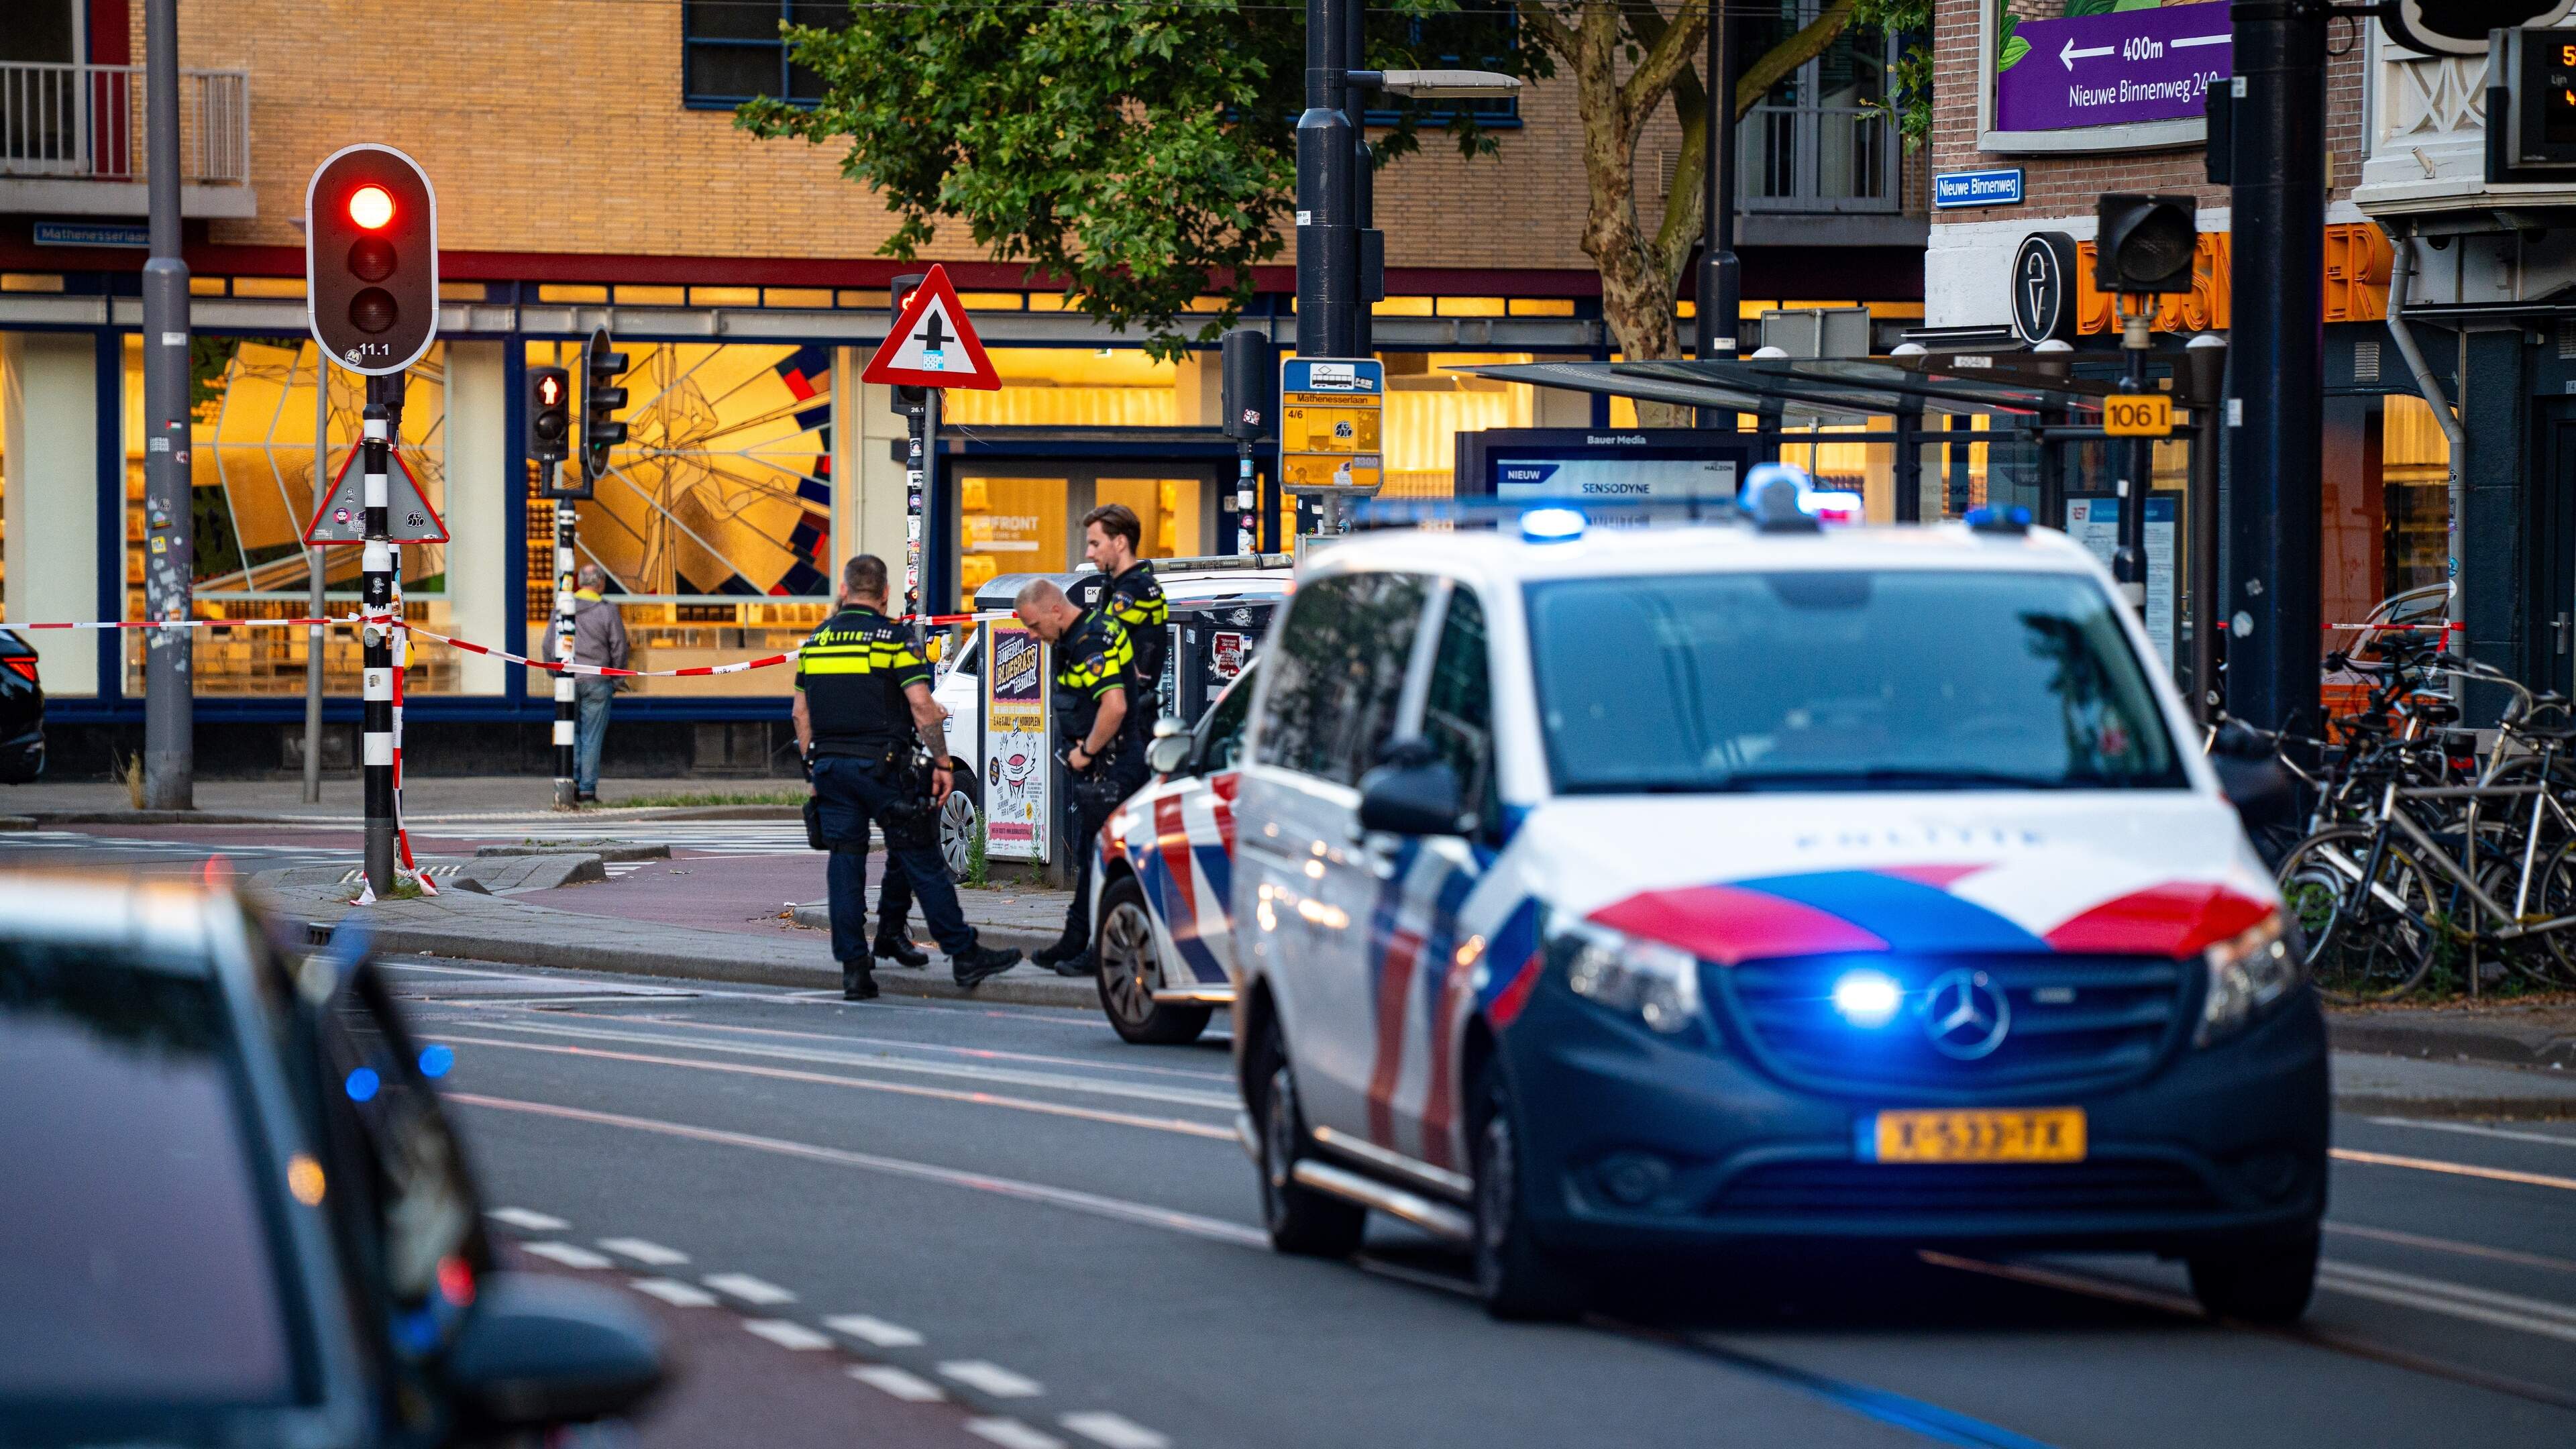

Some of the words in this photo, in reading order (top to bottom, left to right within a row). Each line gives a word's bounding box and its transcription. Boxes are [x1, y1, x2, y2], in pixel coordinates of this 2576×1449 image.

[2123, 36, 2163, 61] 400m
[2070, 85, 2116, 107] Nieuwe
[2120, 79, 2192, 103] Binnenweg
[1939, 180, 1969, 196] Nieuwe
[1971, 178, 2016, 197] Binnenweg
[360, 343, 389, 356] 11.1
[1297, 393, 1368, 404] Mathenesserlaan
[1288, 410, 1303, 419] 4/6
[1587, 435, 1615, 444] Bauer
[1617, 435, 1646, 444] Media
[1507, 470, 1540, 480] NIEUW
[1582, 483, 1650, 494] SENSODYNE
[997, 638, 1024, 665] ROTTERDAM
[997, 646, 1036, 686] BLUEGRASS
[1014, 670, 1036, 694] FESTIVAL
[1020, 716, 1040, 727] NOORDPLEIN
